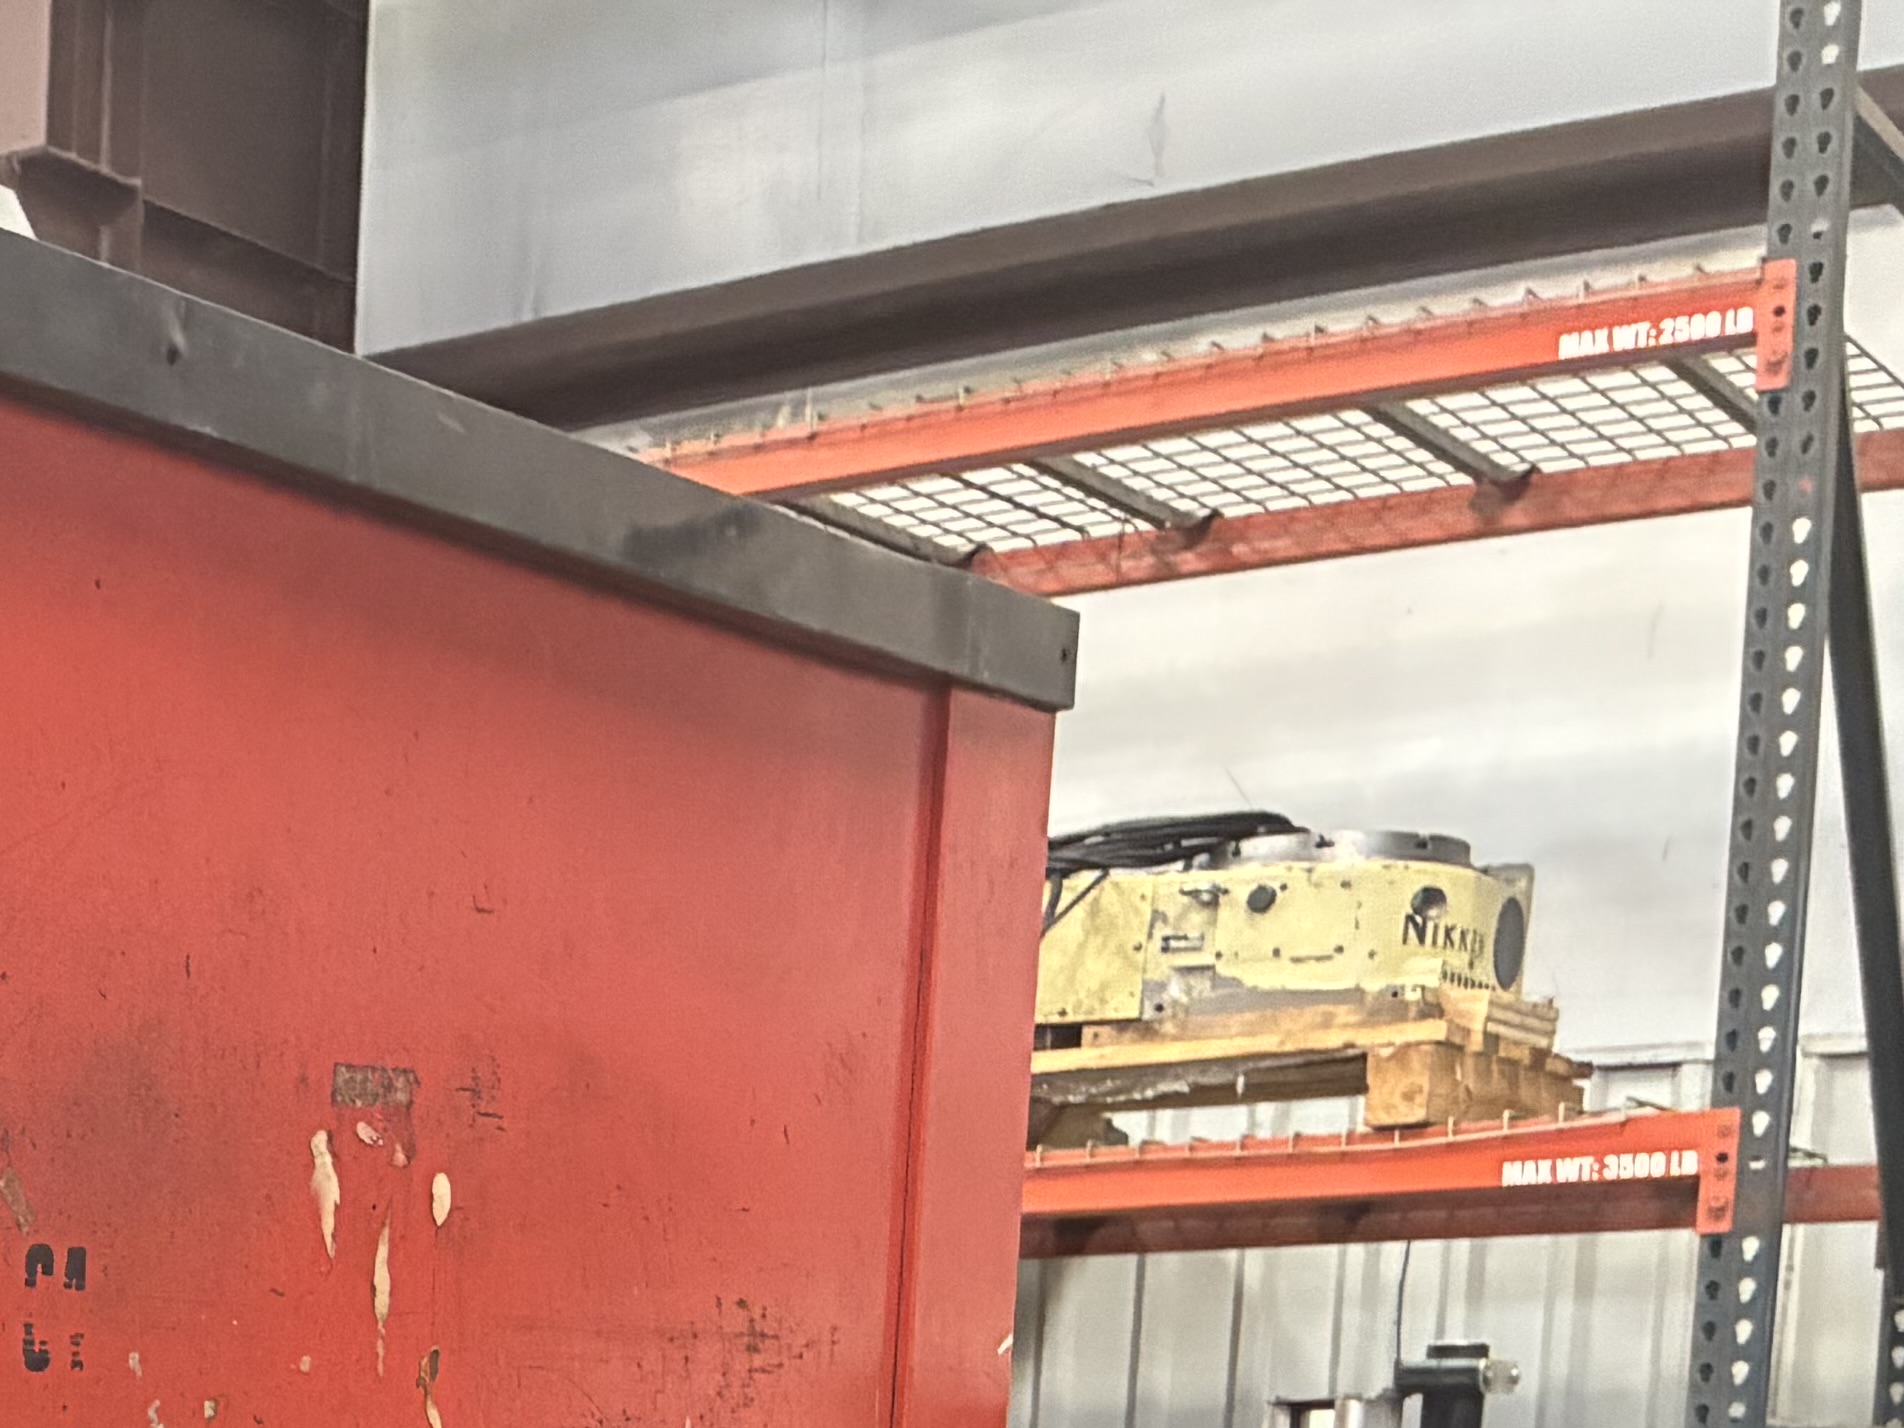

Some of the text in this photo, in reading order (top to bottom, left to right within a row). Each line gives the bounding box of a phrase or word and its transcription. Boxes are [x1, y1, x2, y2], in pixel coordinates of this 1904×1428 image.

[1558, 328, 1609, 360] MAX
[1612, 322, 1657, 351] WT:
[1725, 307, 1754, 335] LB
[1502, 1159, 1552, 1188] MAX
[1556, 1156, 1600, 1183] WT:
